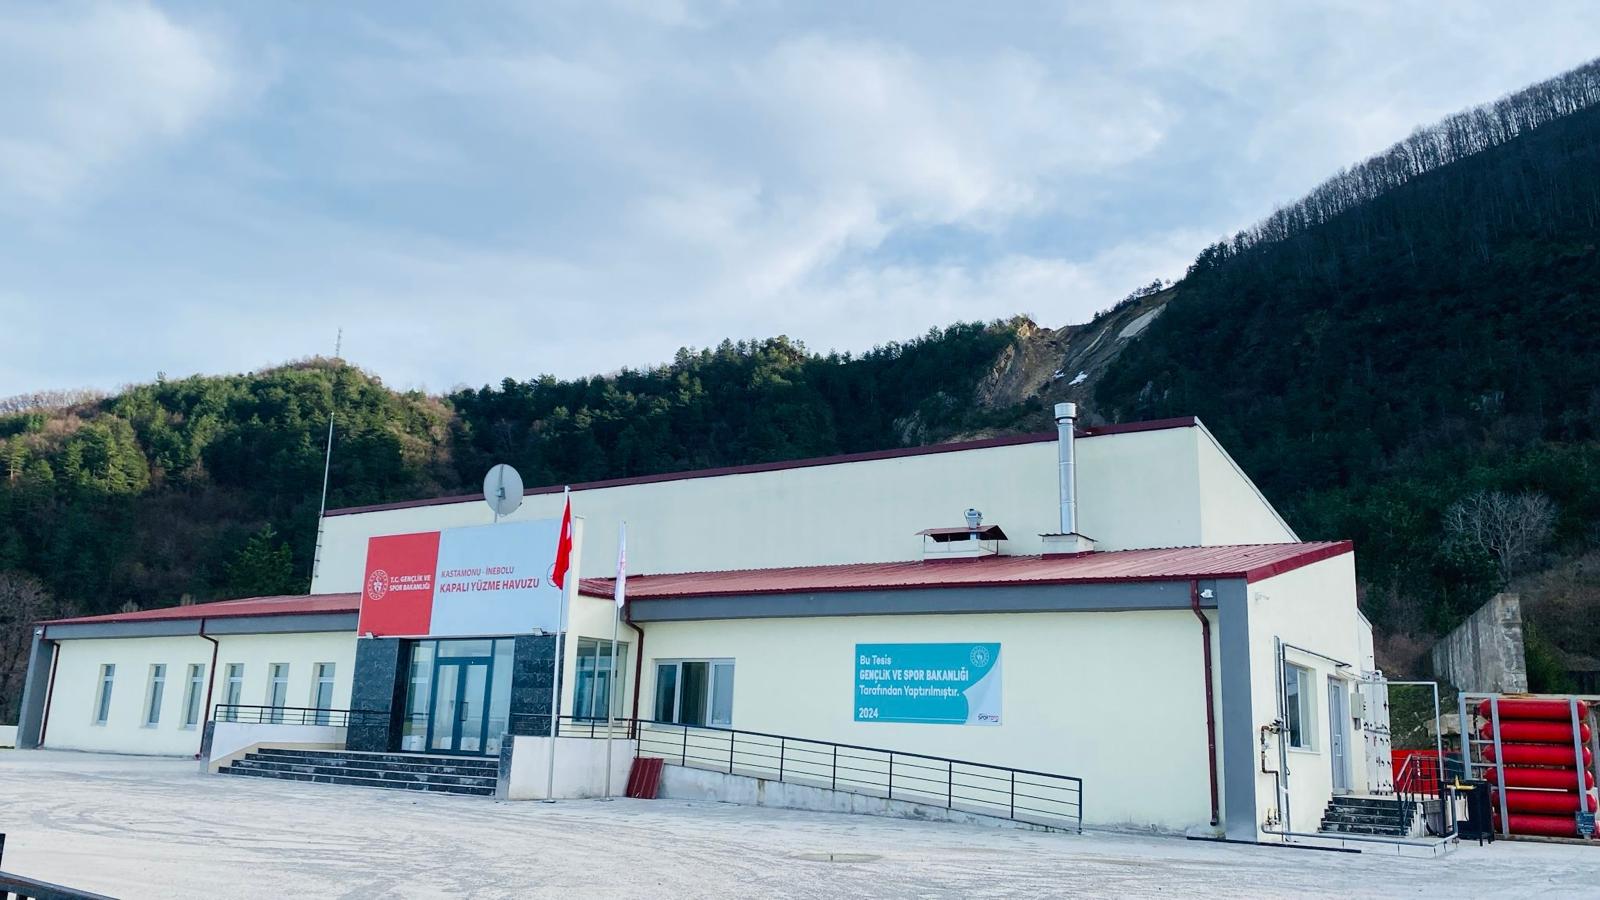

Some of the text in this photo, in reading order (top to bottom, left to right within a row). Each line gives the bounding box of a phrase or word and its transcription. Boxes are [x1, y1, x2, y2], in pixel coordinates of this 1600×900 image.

[441, 569, 481, 578] KASTAMONU
[485, 566, 514, 575] İNEBOLU
[400, 574, 422, 583] GENÇLİK
[389, 582, 430, 592] SPOR BAKANLIĞI
[440, 578, 540, 592] KAPALI YÜZME HAVUZU
[860, 654, 892, 665] Bu Tesis
[892, 669, 902, 681] VE
[903, 669, 925, 681] SPOR
[925, 666, 968, 681] BAKANLIĞI
[859, 685, 960, 699] Tarafından Yaptırılmıştır.
[859, 707, 878, 719] 2024
